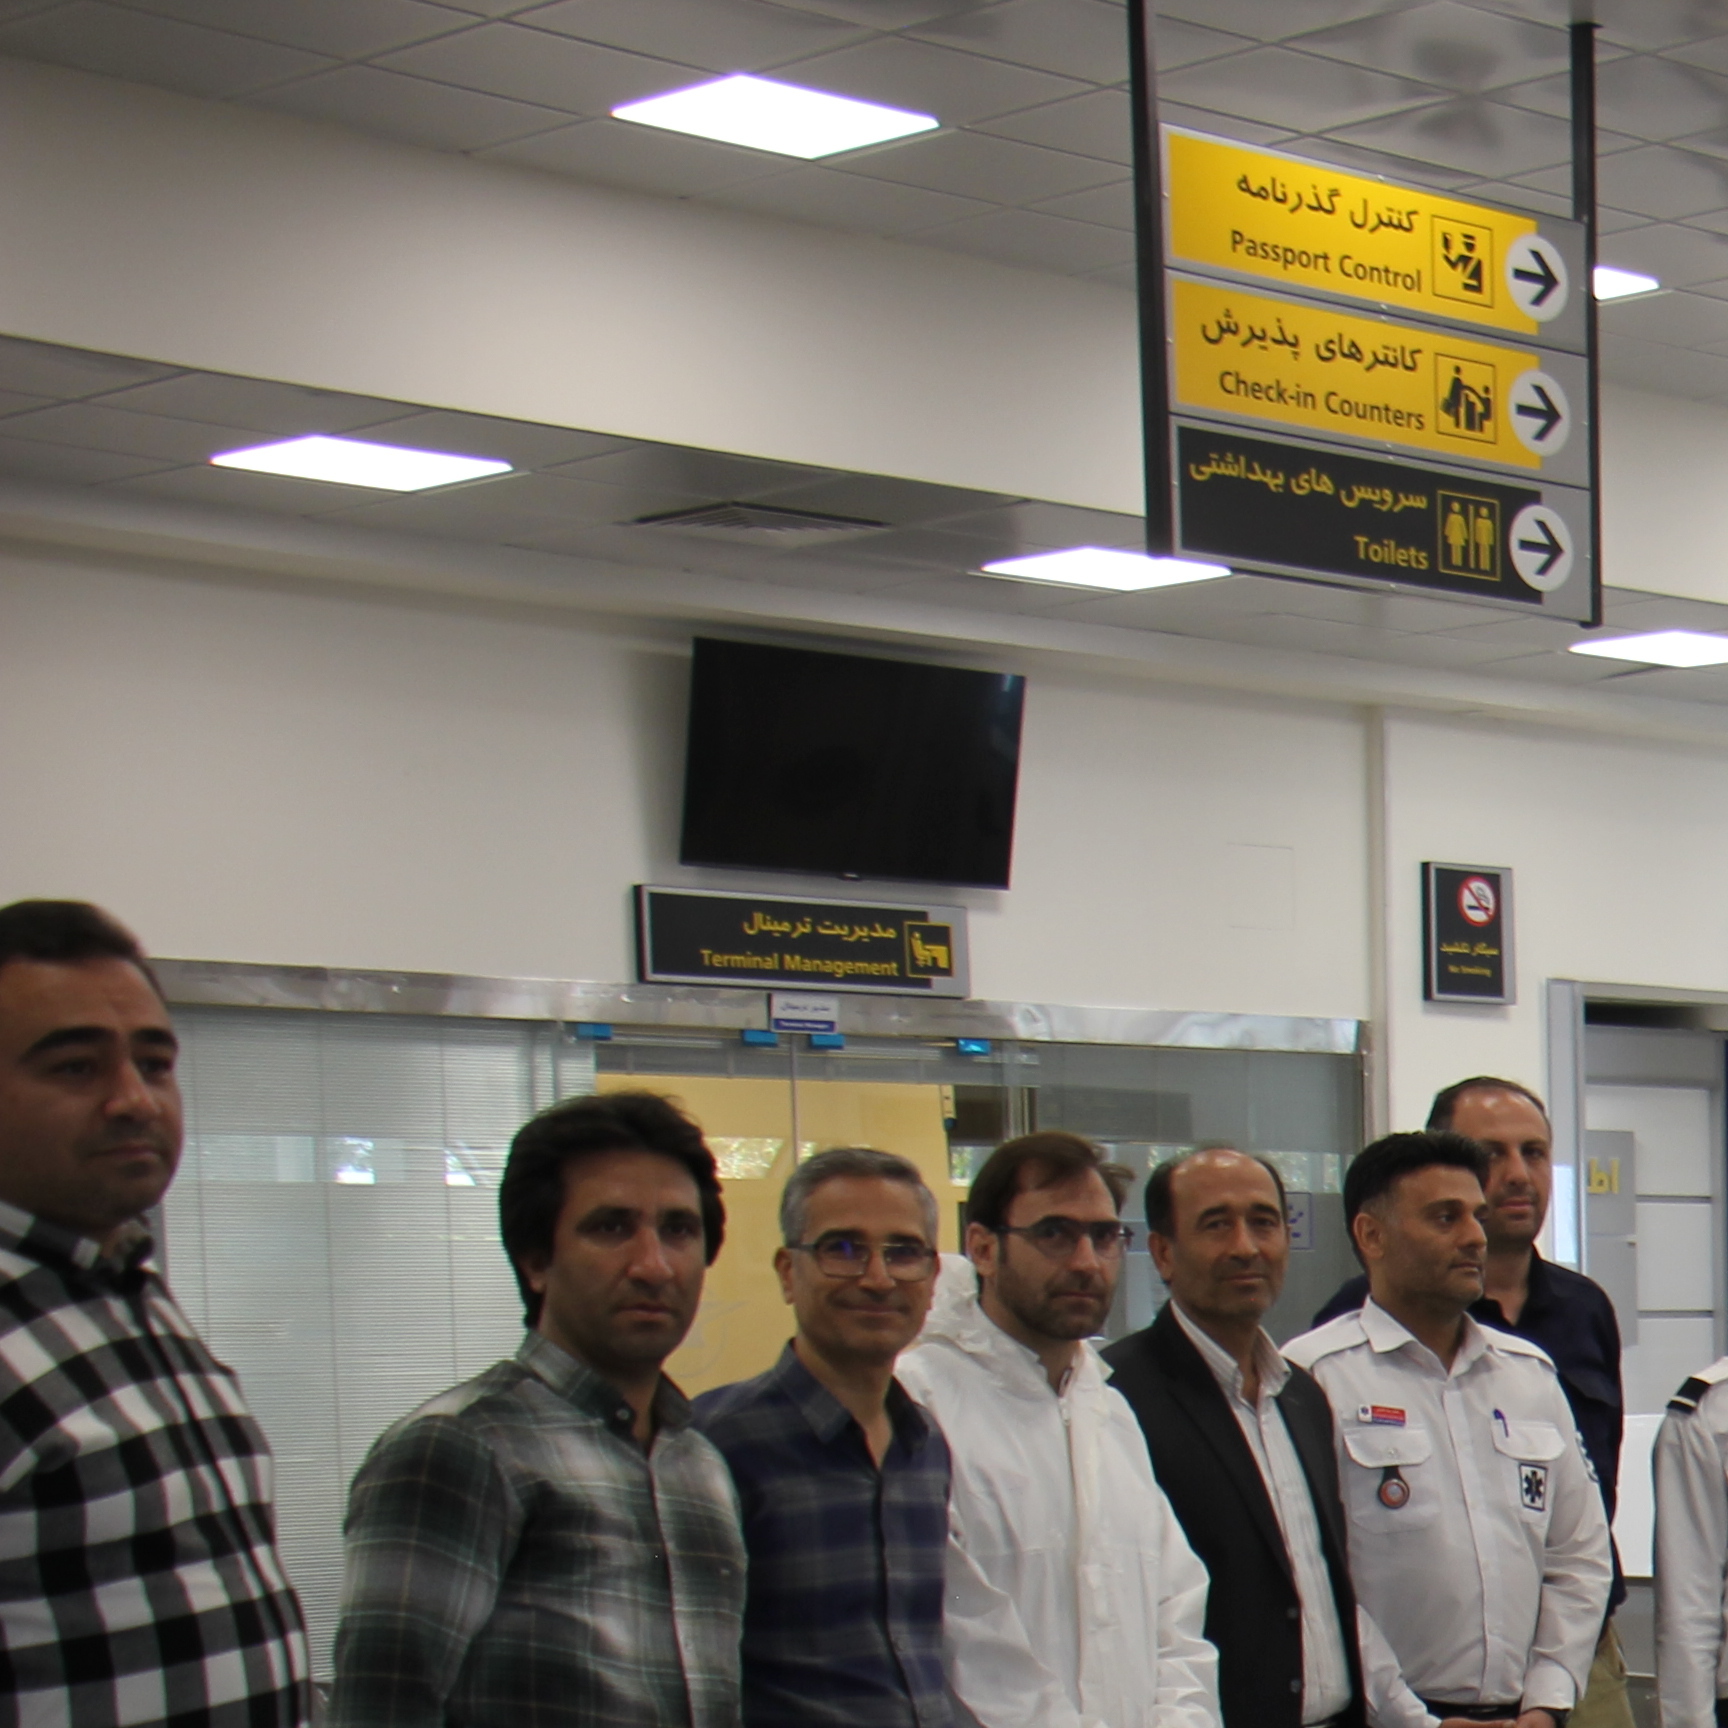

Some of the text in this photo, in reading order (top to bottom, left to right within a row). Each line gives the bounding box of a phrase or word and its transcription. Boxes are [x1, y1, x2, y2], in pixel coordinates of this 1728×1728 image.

[1236, 172, 1420, 236] کنترل گذرنامه
[1231, 230, 1422, 294] Passport Control
[1201, 307, 1423, 374] کانترهای پذیرش
[1219, 370, 1425, 431] Check-in Counters
[1188, 449, 1429, 512] سرویس های بهداشتی
[1353, 535, 1429, 570] Toilets
[742, 911, 897, 943] مدیریت ترمینال
[700, 949, 900, 978] Terminal Management
